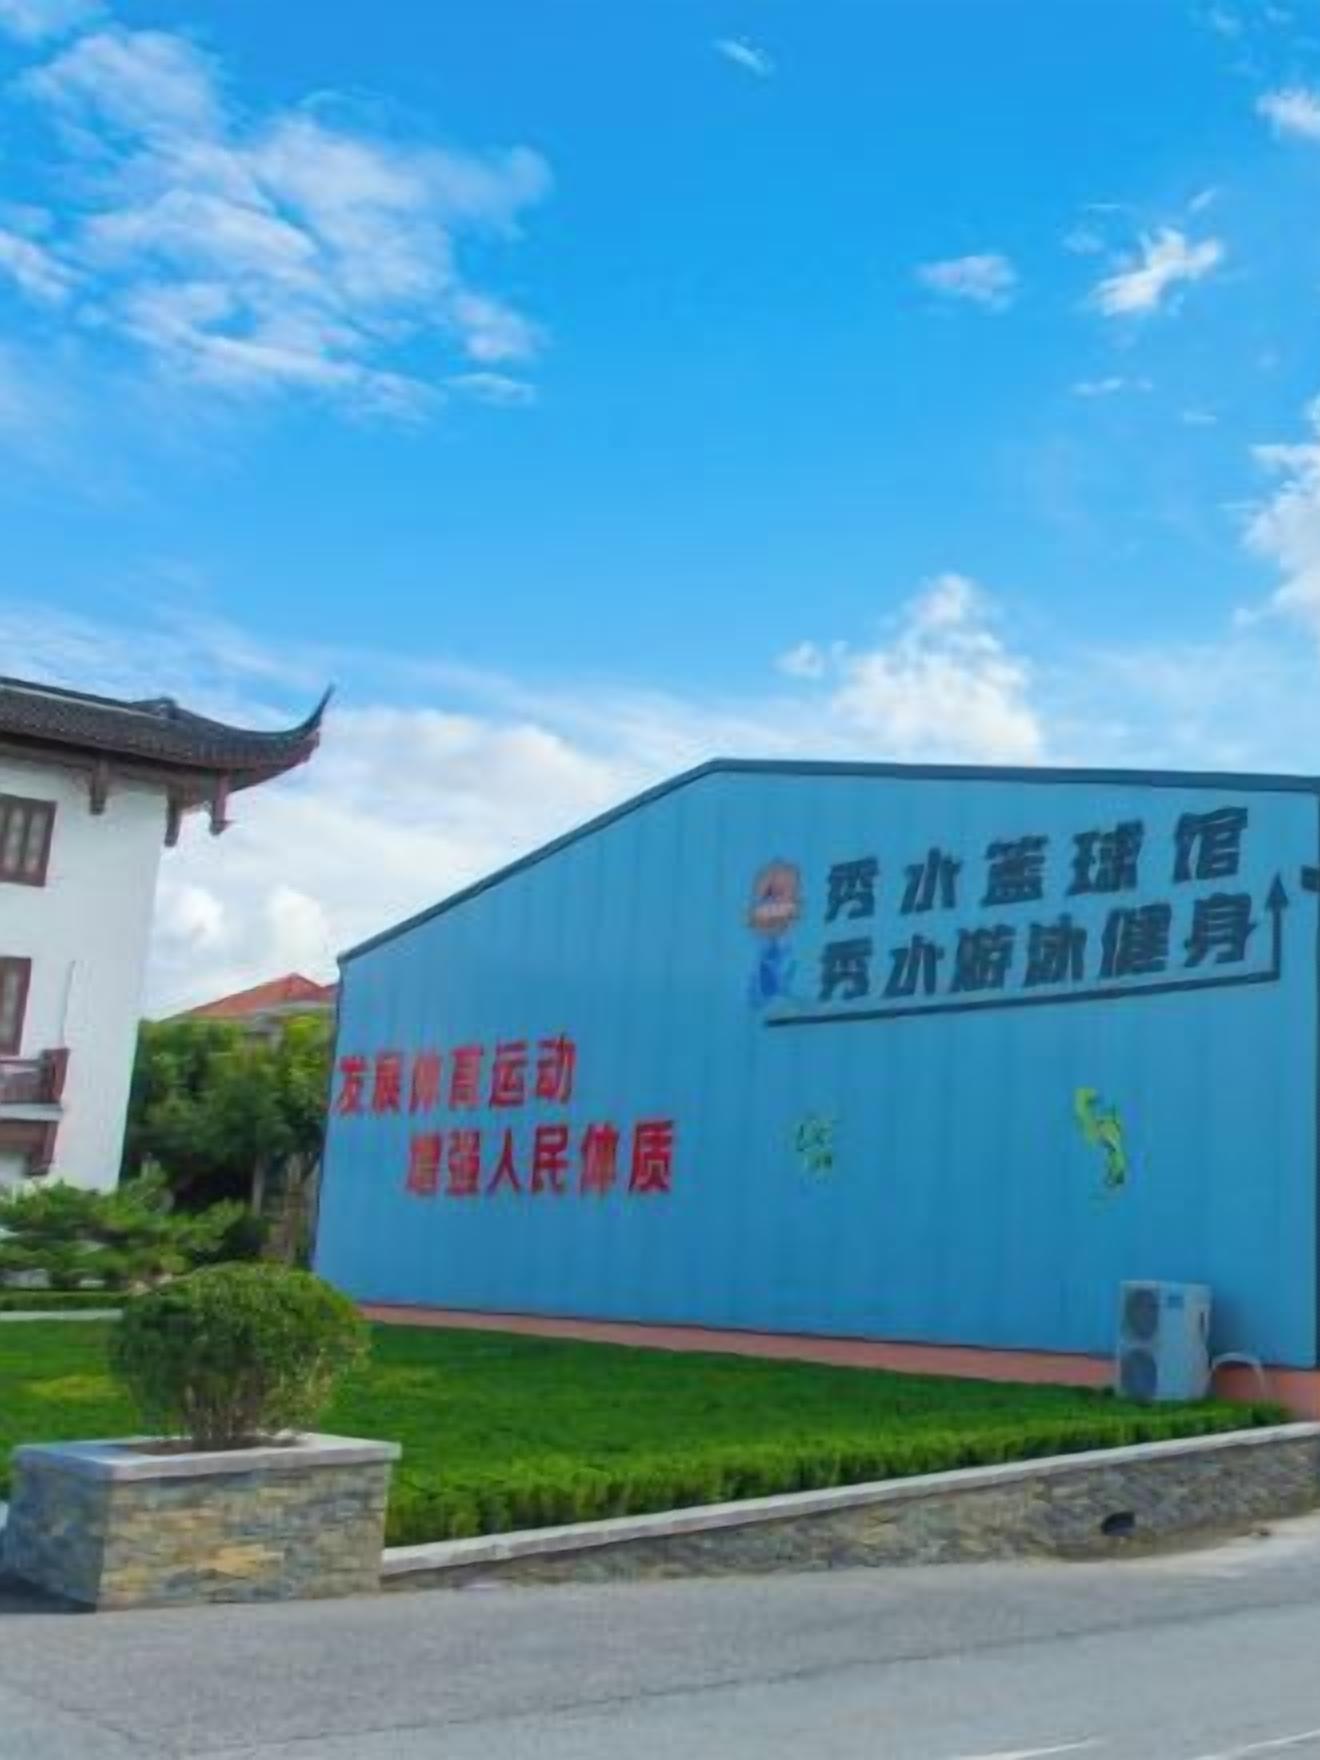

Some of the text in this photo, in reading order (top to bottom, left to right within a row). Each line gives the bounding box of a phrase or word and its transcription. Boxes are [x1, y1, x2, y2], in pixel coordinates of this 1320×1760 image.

[825, 807, 1248, 923] 秀水篮球馆
[337, 1033, 577, 1115] 发展体育运动
[406, 1119, 675, 1196] 增强人民体质
